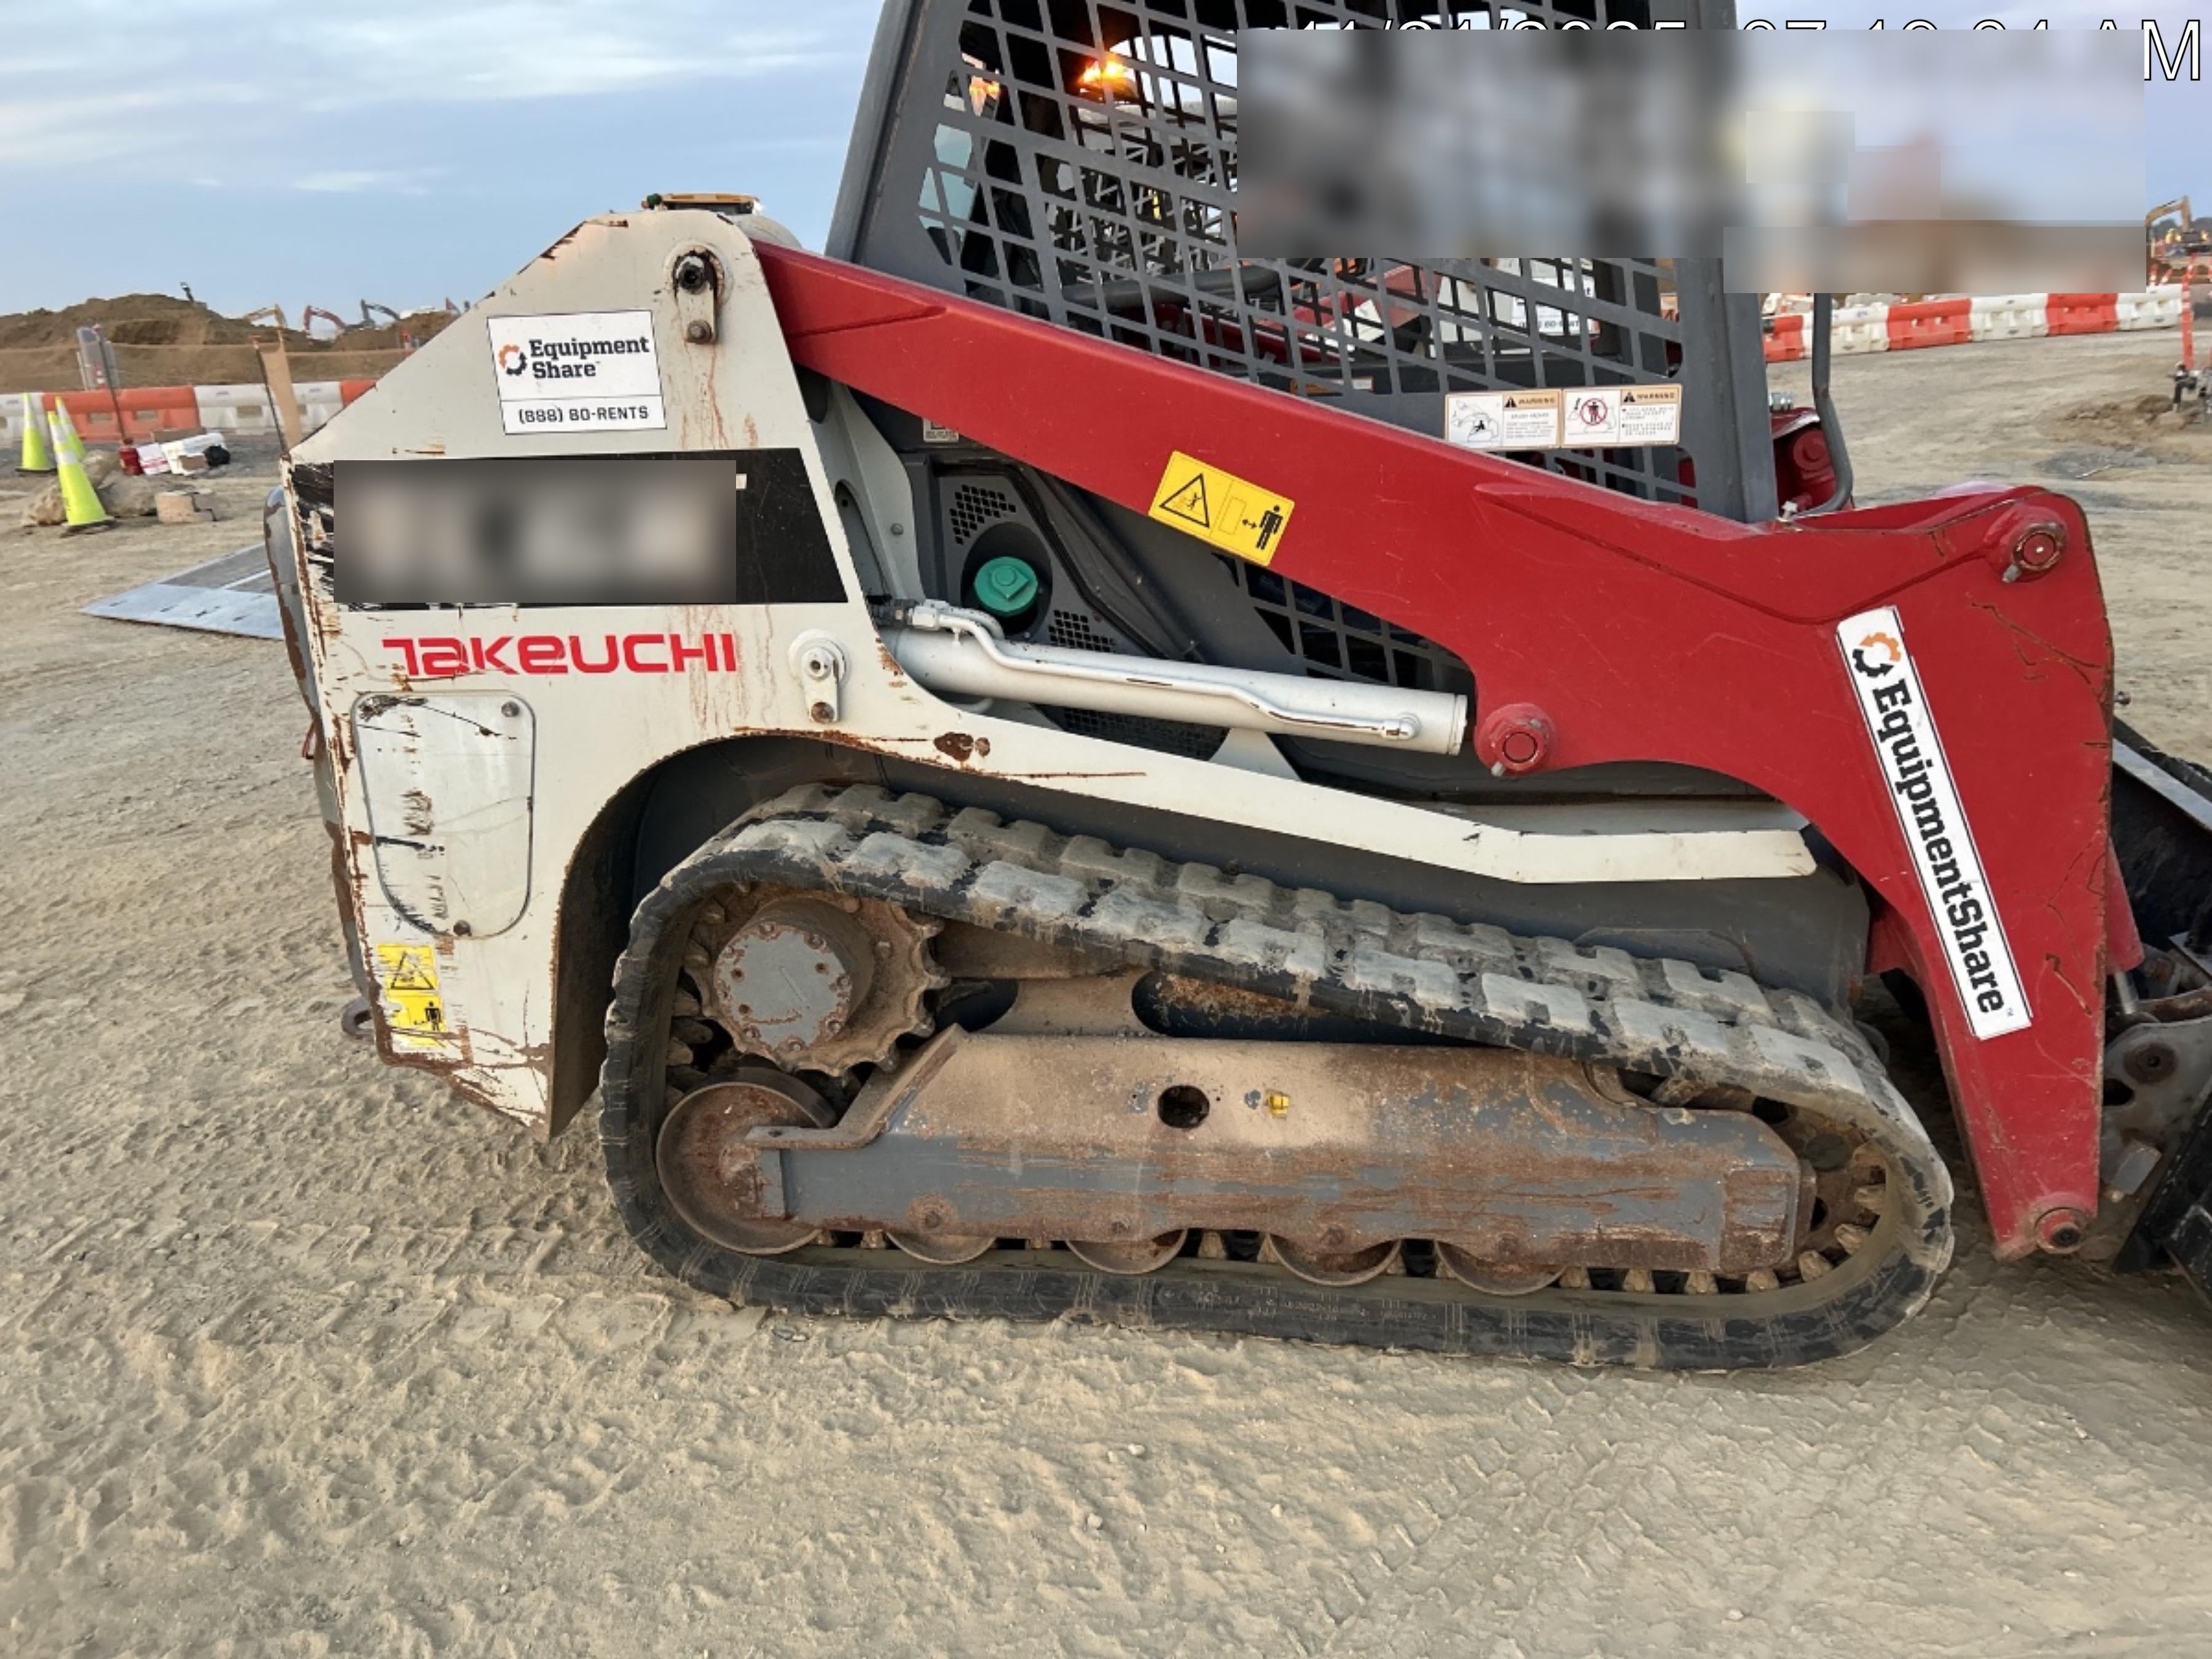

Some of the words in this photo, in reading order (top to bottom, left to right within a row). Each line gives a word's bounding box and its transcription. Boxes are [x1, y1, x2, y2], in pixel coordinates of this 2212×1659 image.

[528, 336, 649, 361] Equipment
[532, 361, 596, 378] Share
[519, 407, 563, 424] (888)
[1873, 678, 2004, 1014] EquipmentShare
